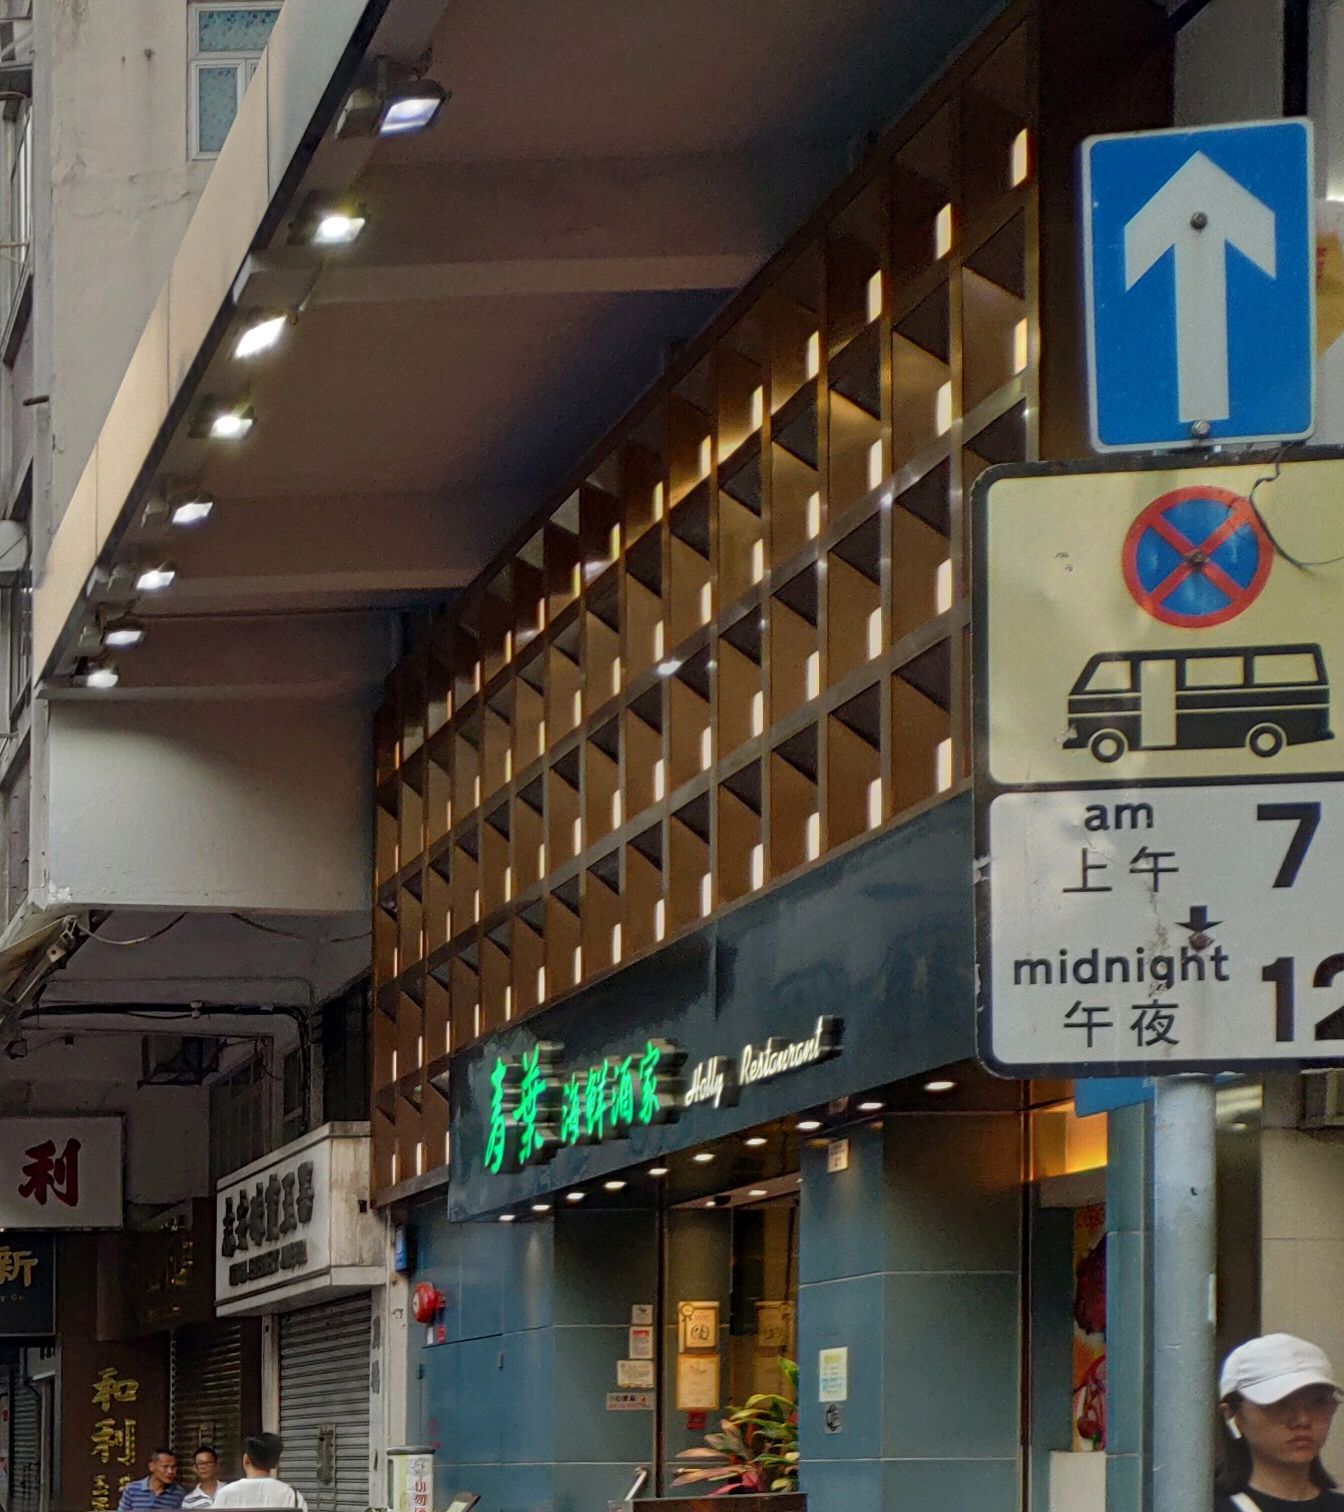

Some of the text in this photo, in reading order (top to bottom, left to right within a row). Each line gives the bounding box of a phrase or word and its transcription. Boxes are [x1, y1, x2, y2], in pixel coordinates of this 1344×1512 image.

[1084, 801, 1154, 832] am
[1257, 801, 1322, 888] 7
[1063, 846, 1180, 893] 上午
[1014, 945, 1230, 992] midnight
[1063, 999, 1180, 1048] 午夜
[685, 1014, 823, 1109] Holly Restaurant
[91, 1366, 140, 1466] 和利
